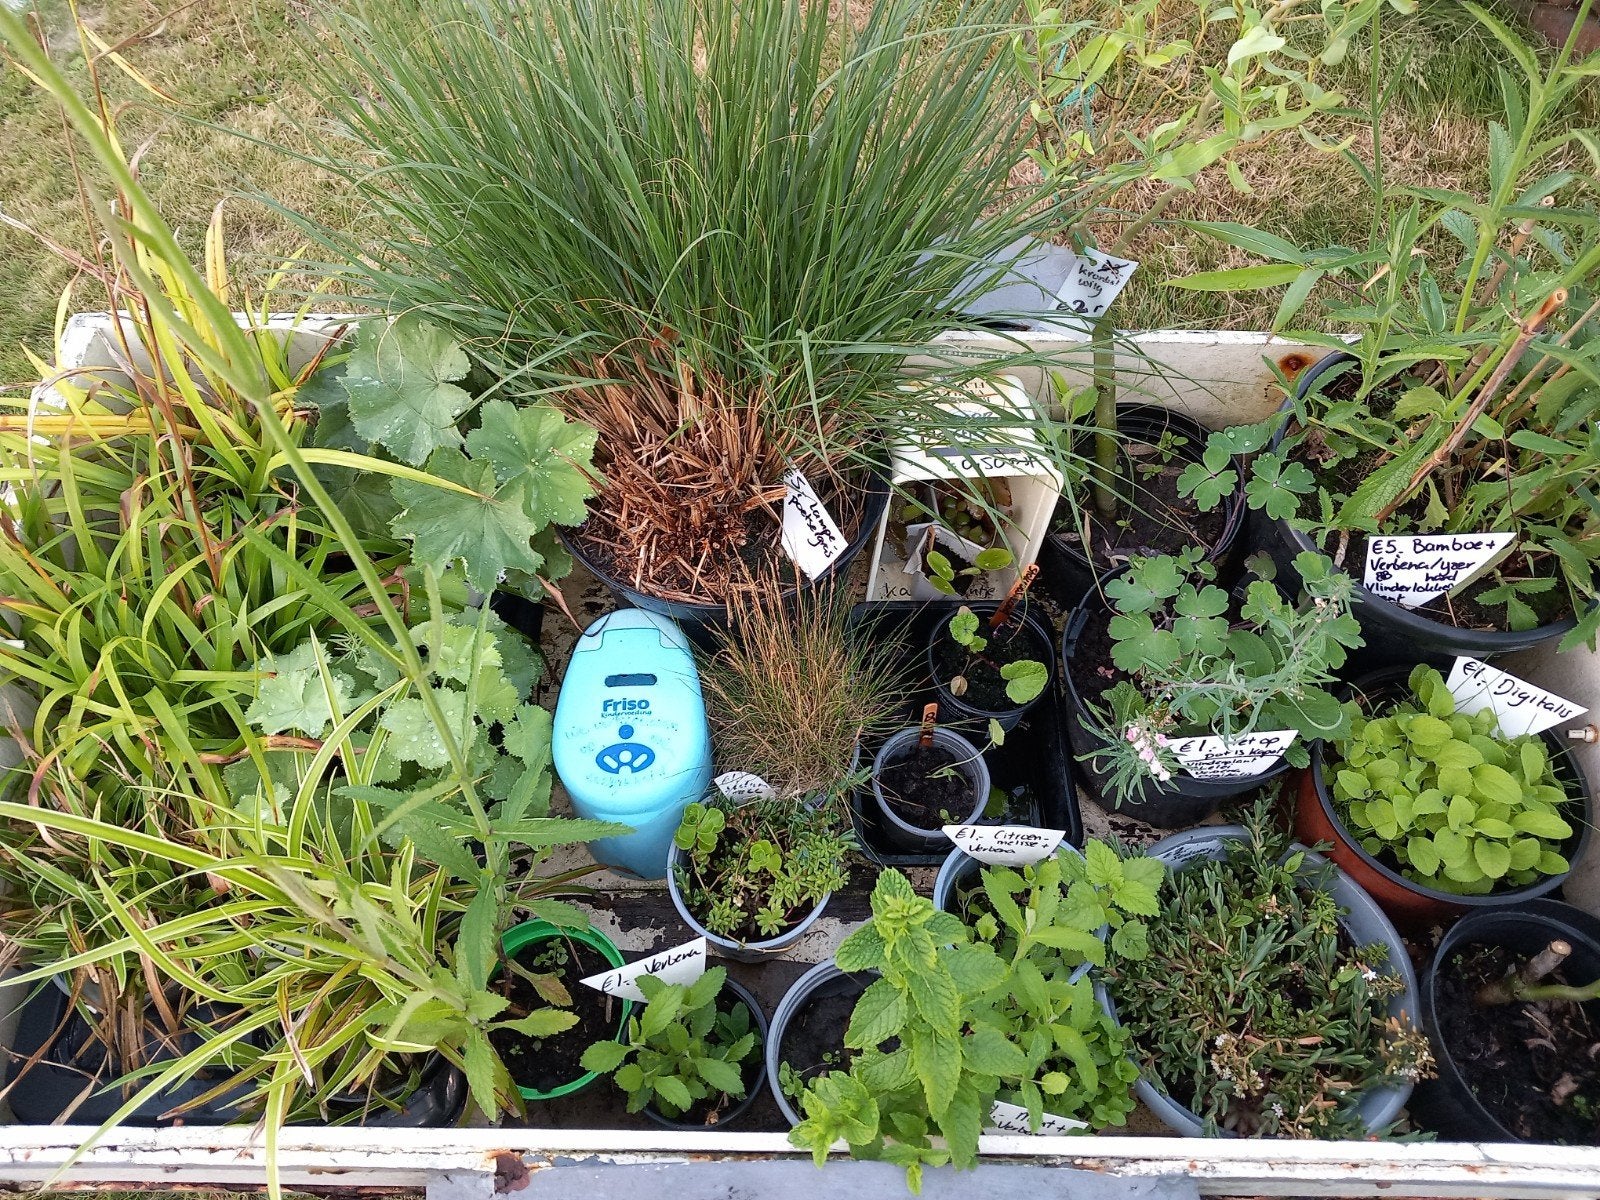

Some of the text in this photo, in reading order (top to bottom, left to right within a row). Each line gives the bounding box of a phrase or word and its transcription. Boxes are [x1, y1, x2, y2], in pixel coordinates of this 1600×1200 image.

[1413, 537, 1484, 554] Bamboe
[602, 697, 650, 712] Friso
[1493, 678, 1573, 718] Digitalis
[644, 949, 702, 974] Verbena
